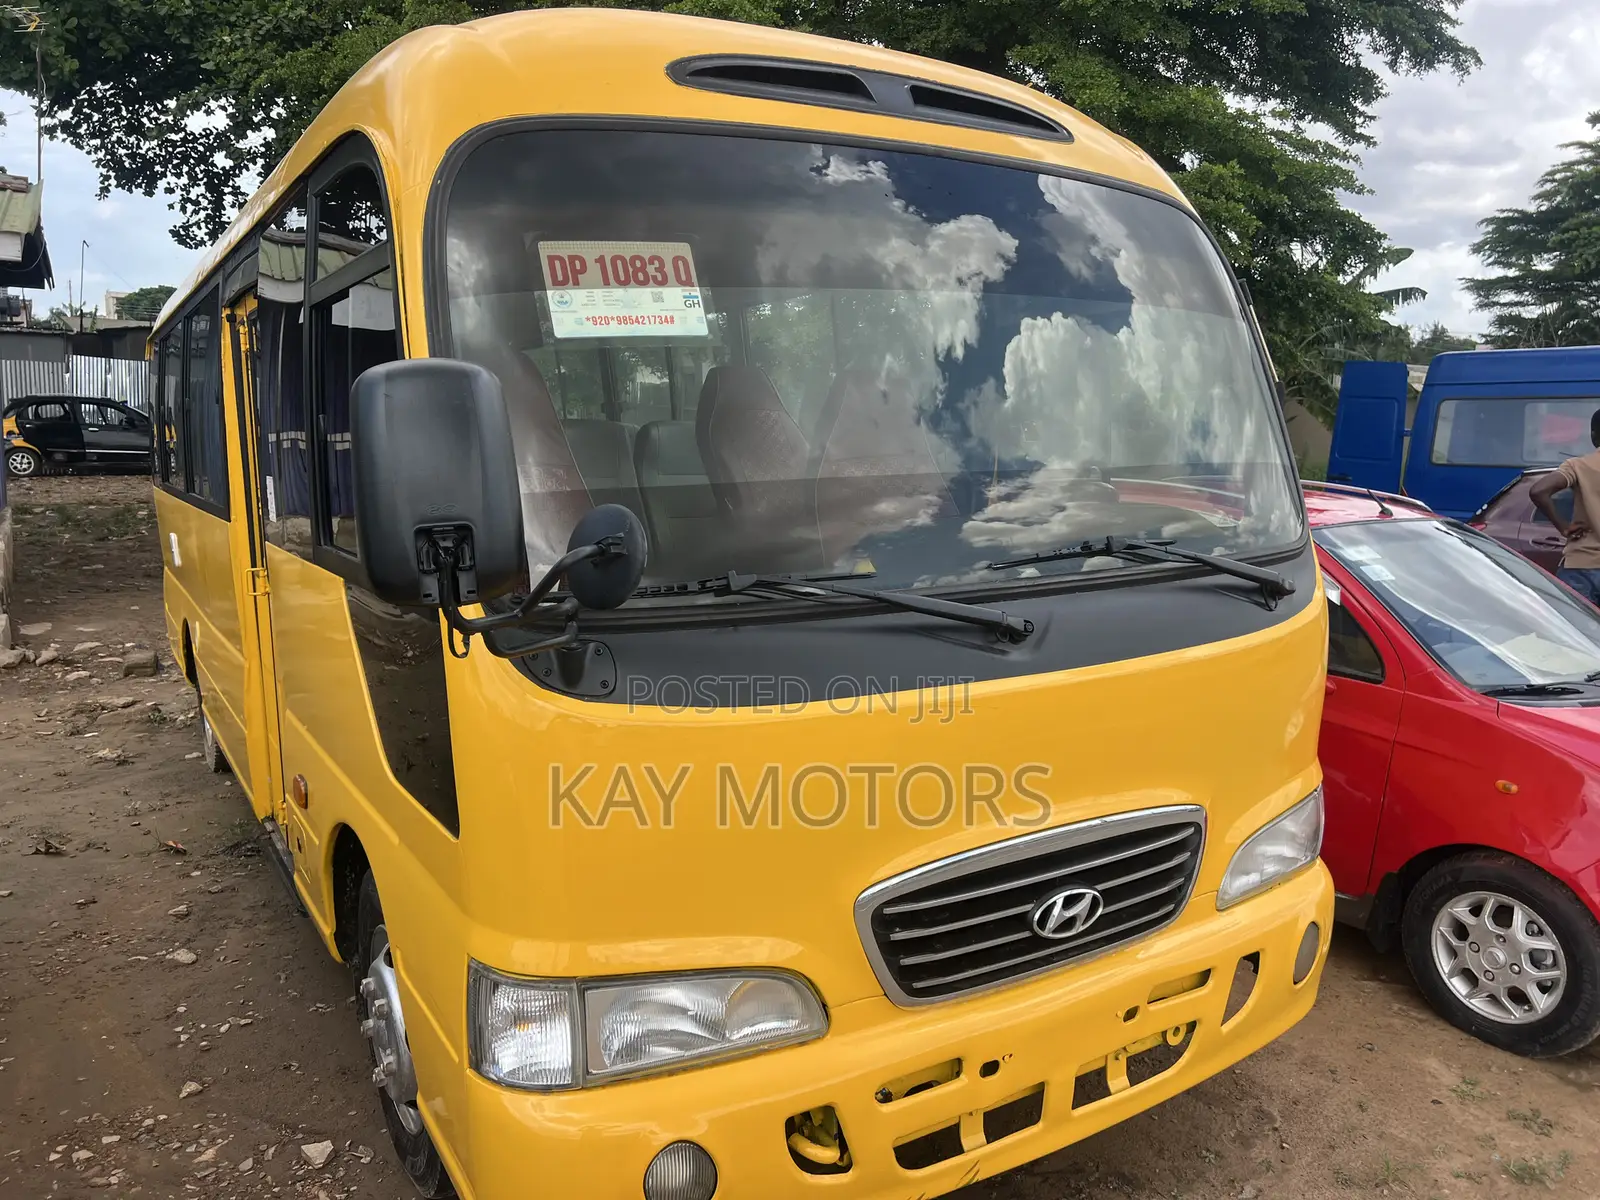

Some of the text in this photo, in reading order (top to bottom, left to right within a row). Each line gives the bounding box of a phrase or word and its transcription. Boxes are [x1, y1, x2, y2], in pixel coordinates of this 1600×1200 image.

[547, 254, 694, 287] DP 1083 Q
[684, 299, 701, 309] GH
